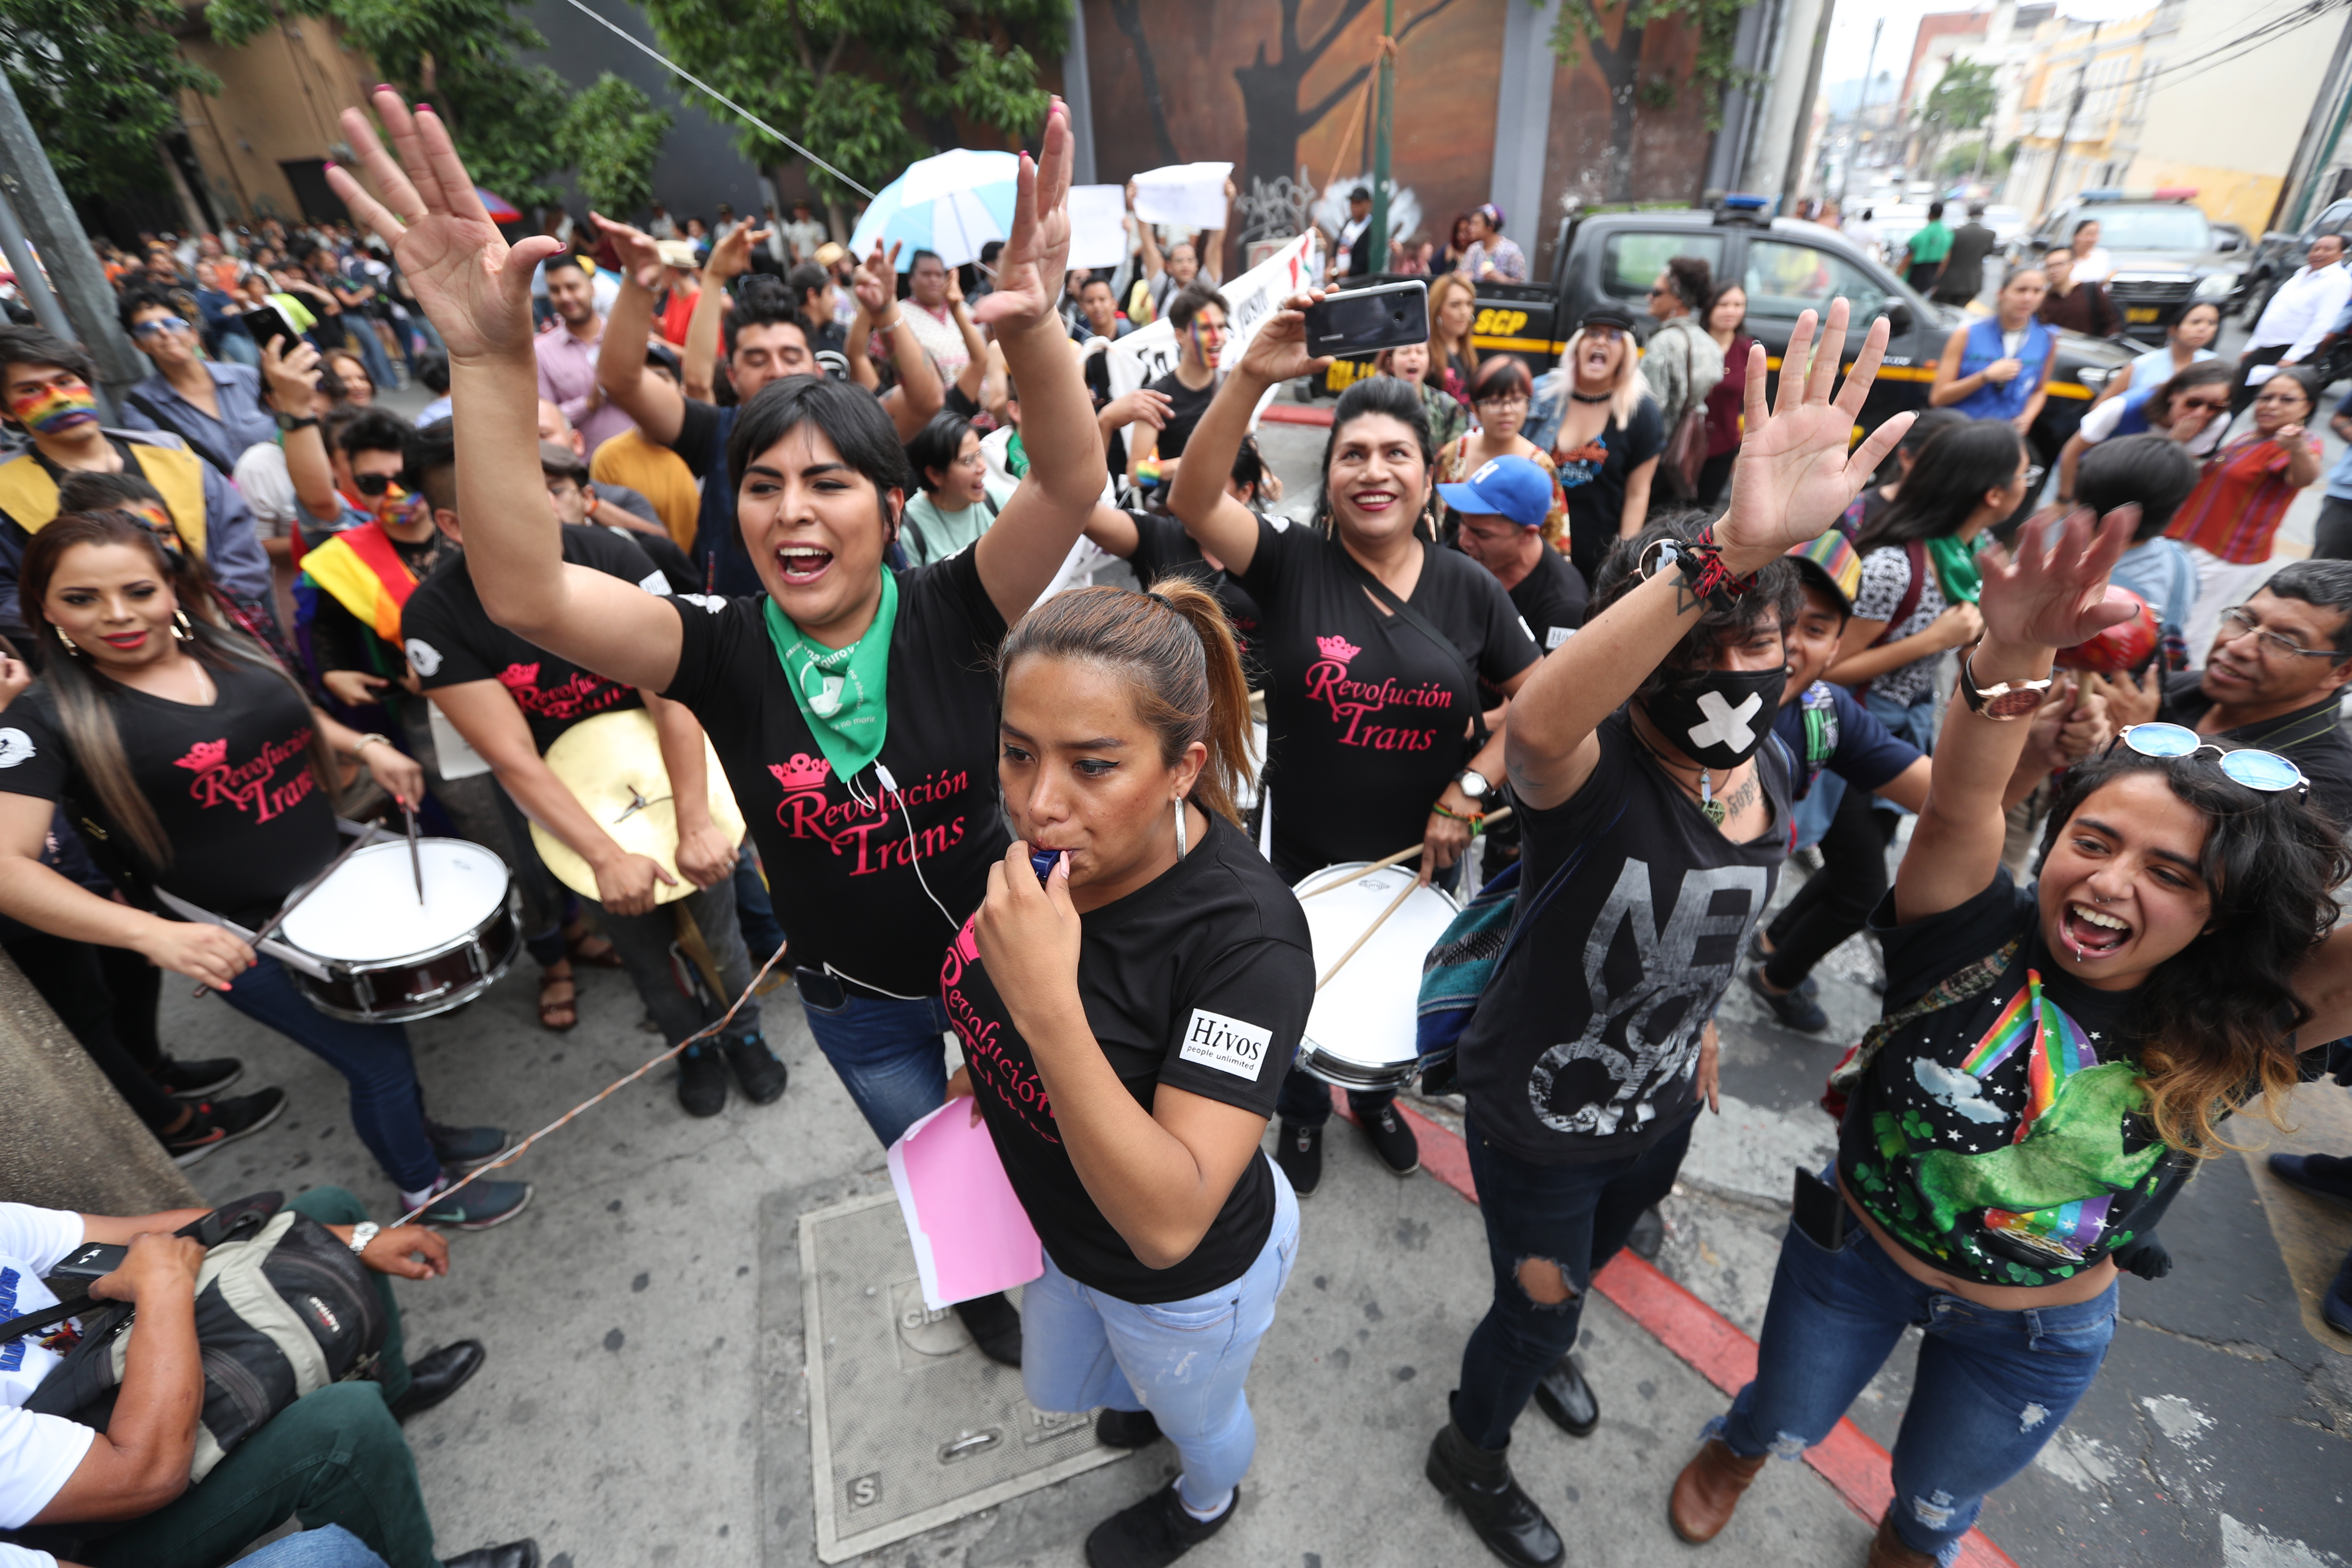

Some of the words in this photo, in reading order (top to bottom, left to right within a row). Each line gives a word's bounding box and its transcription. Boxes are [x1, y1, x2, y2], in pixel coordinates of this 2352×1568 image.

[1473, 308, 1528, 336] SCP
[1305, 660, 1452, 715] Revolución
[1332, 701, 1437, 750] Trans
[776, 769, 968, 845] Revolución
[830, 812, 965, 876] Trans
[1187, 1046, 1213, 1057] people
[1216, 1054, 1255, 1070] unlimited
[1191, 1017, 1262, 1060] Hivos
[854, 1478, 876, 1506] S
